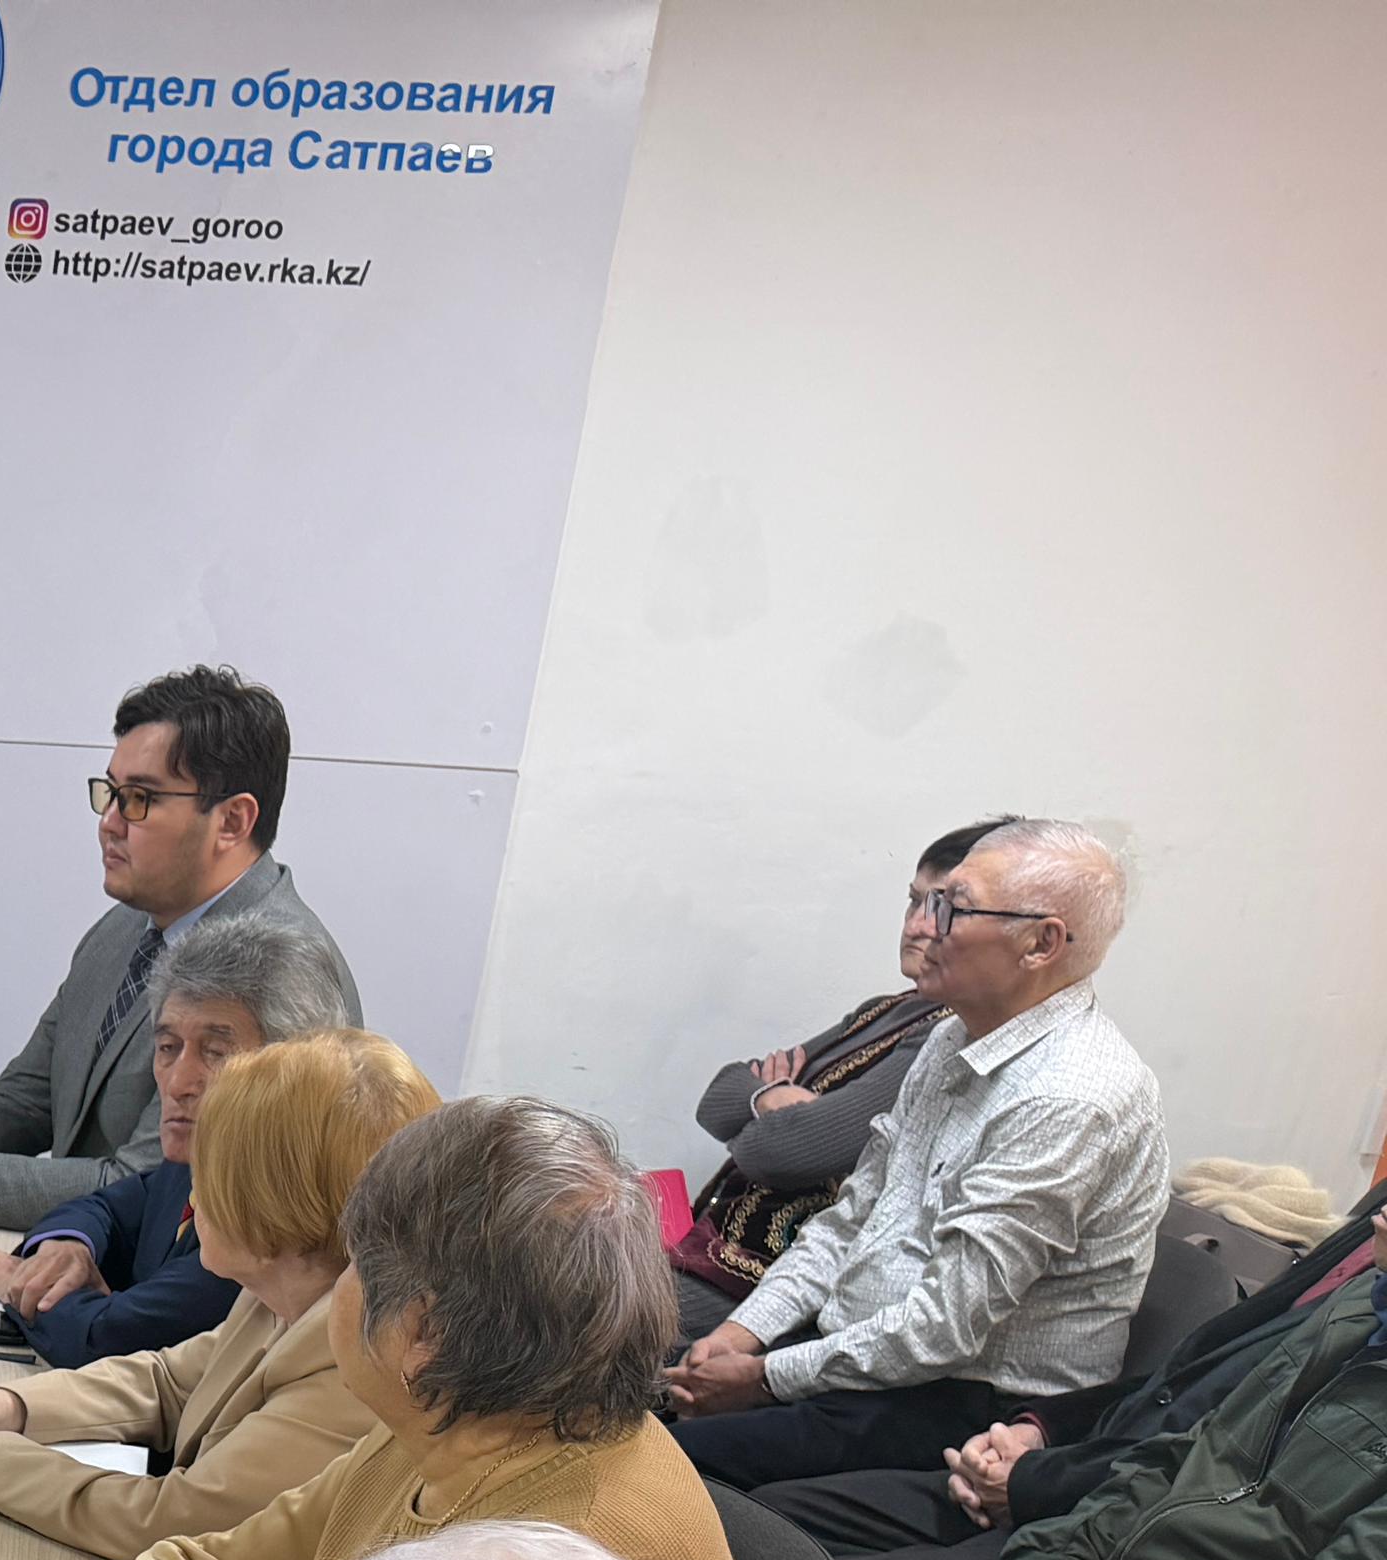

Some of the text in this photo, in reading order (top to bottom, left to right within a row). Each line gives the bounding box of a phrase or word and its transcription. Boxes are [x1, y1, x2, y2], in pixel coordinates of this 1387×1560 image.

[69, 66, 556, 118] Отдел образования
[107, 129, 495, 174] города Сатпаев
[53, 208, 284, 244] satpaev_goroo
[51, 249, 372, 287] http://satpaev.rka.kz/
